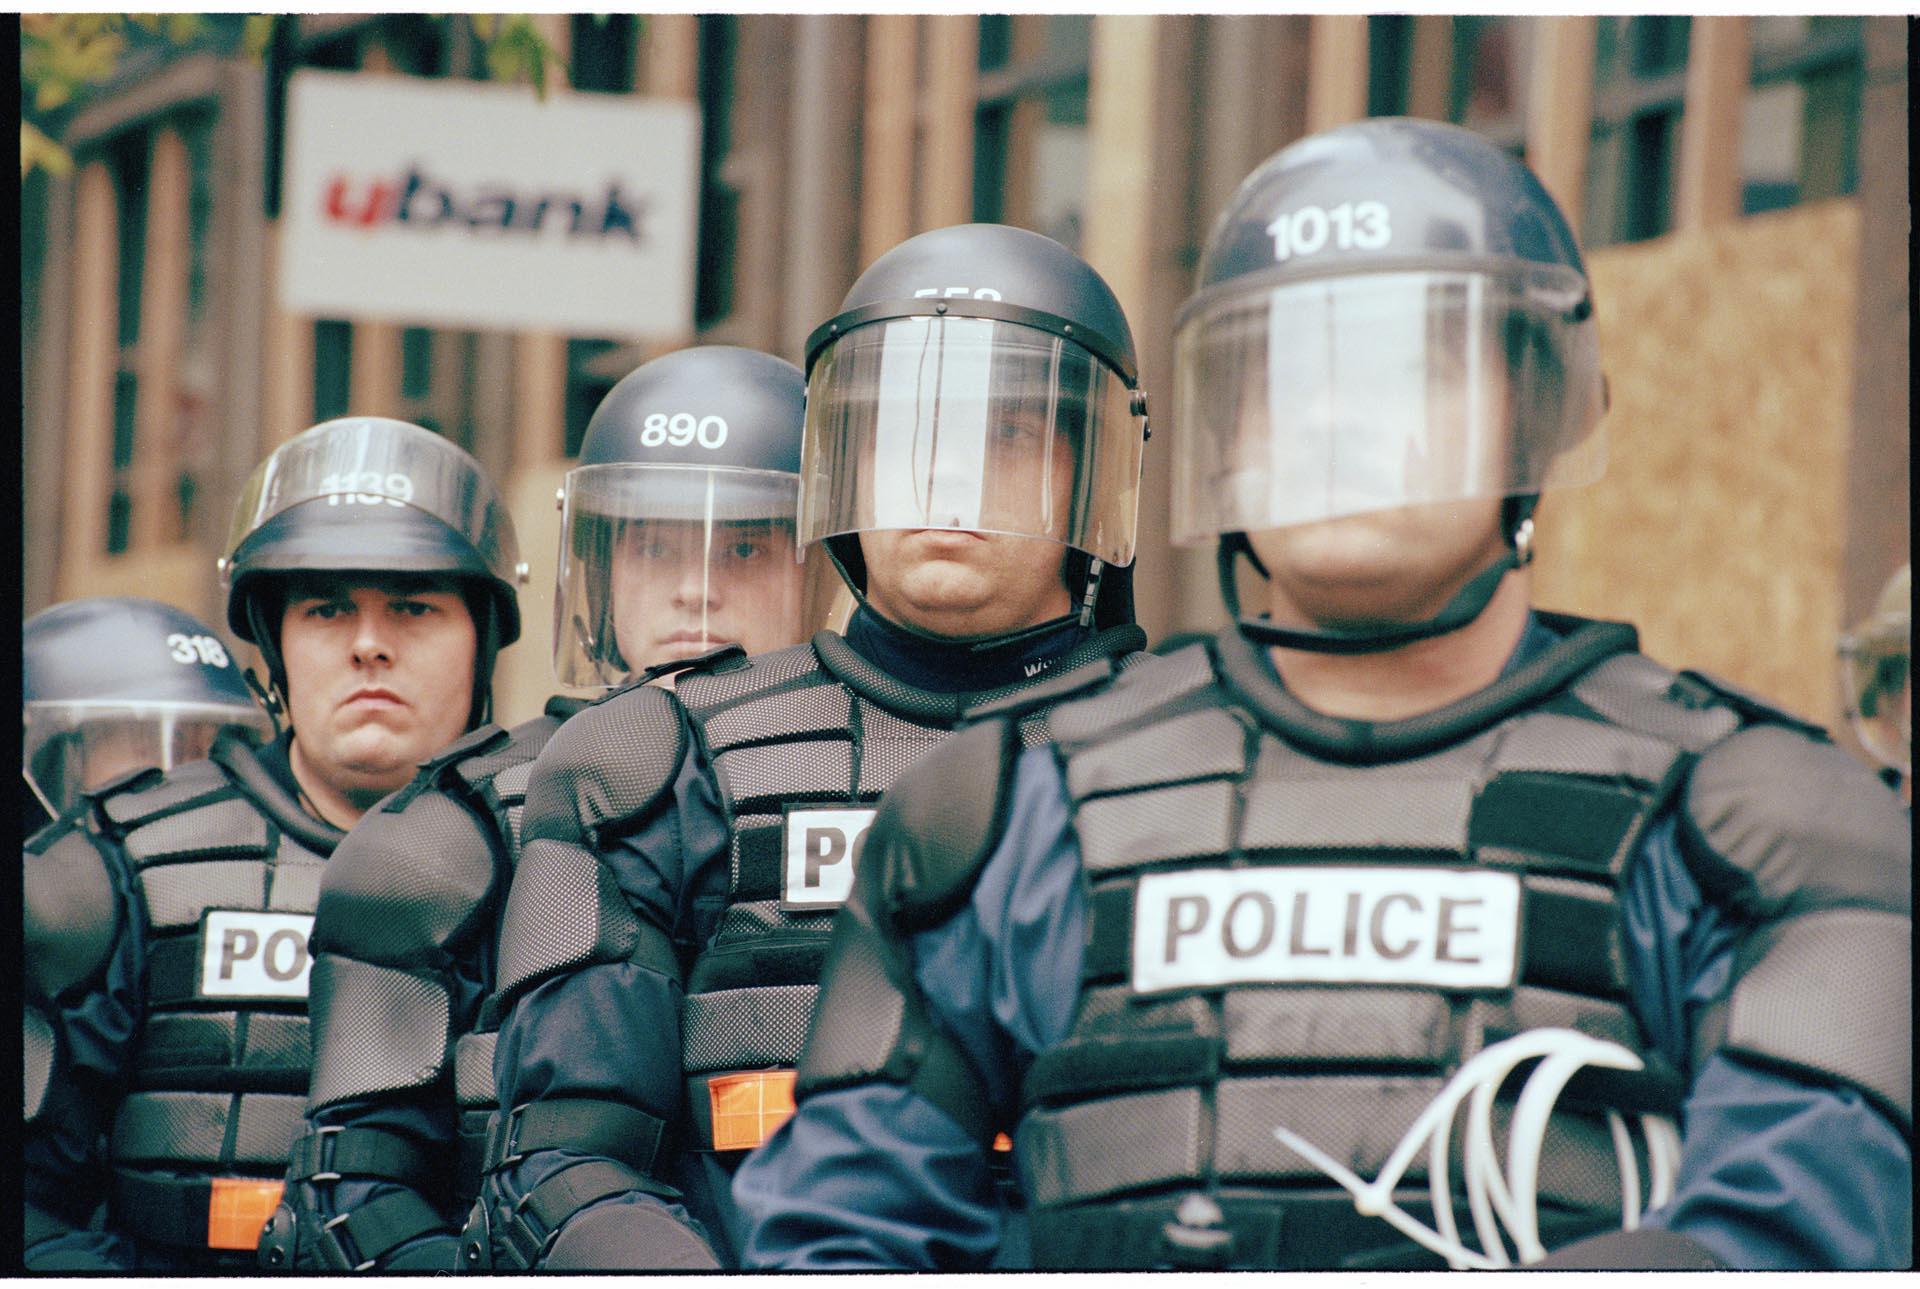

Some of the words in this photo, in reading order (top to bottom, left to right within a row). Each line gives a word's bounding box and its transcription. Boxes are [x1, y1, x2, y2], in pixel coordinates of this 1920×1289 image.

[1266, 201, 1392, 261] 1013
[641, 412, 728, 449] 890
[320, 472, 413, 507] 1139
[167, 633, 228, 668] 318
[1164, 891, 1483, 964] POLICE
